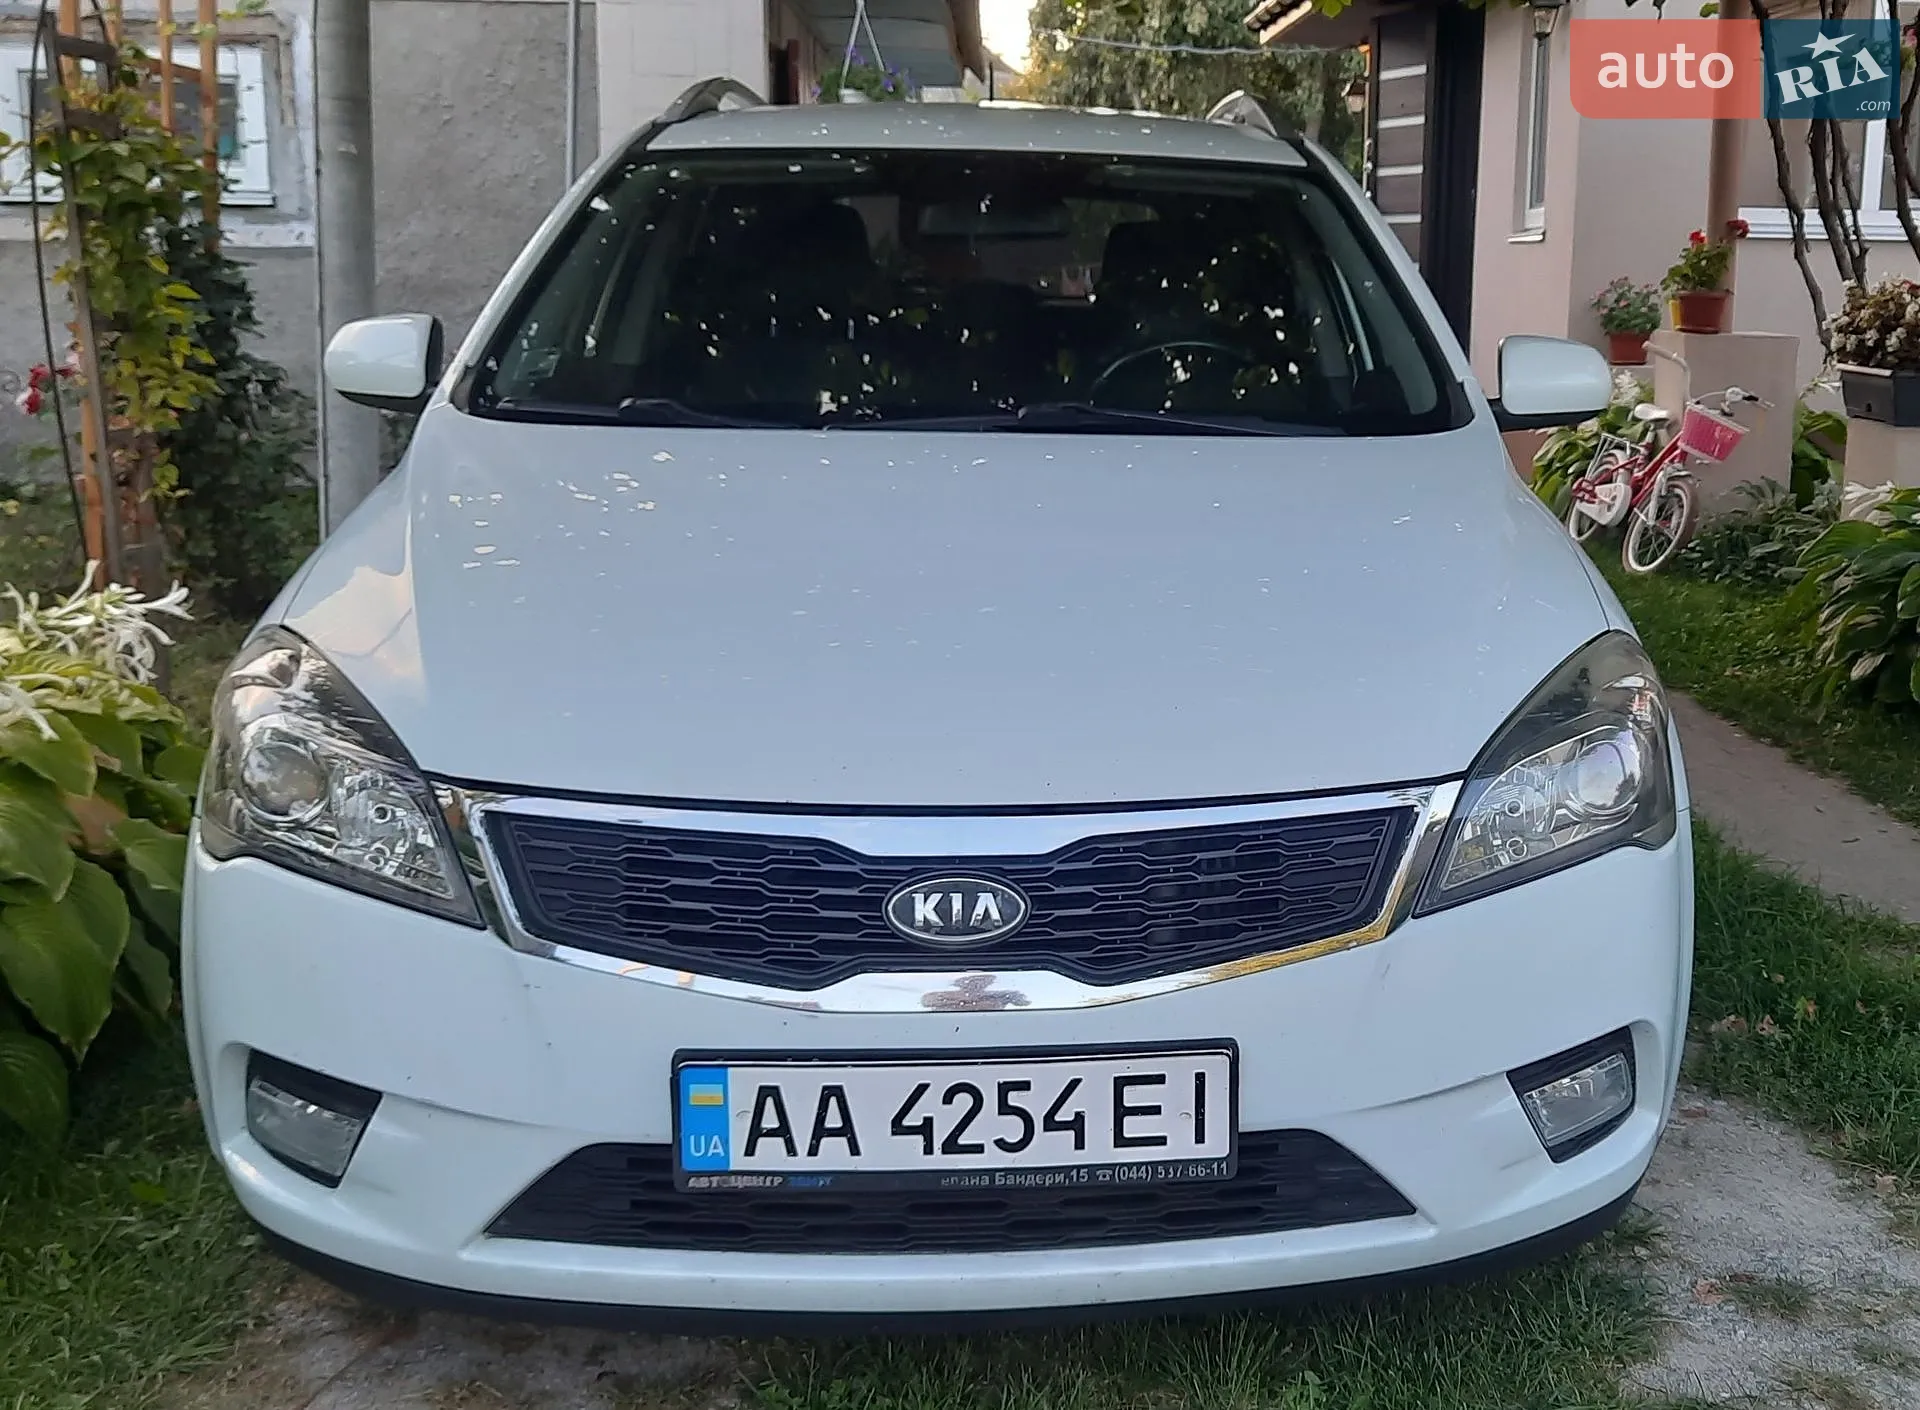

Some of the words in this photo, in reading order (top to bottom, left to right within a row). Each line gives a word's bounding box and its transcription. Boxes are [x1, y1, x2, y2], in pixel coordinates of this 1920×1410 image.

[911, 892, 1003, 928] KIA
[743, 1083, 863, 1158] AA
[890, 1076, 1086, 1156] 4254
[1112, 1070, 1207, 1149] EI
[689, 1135, 725, 1158] UA
[1114, 1164, 1153, 1183] (044)
